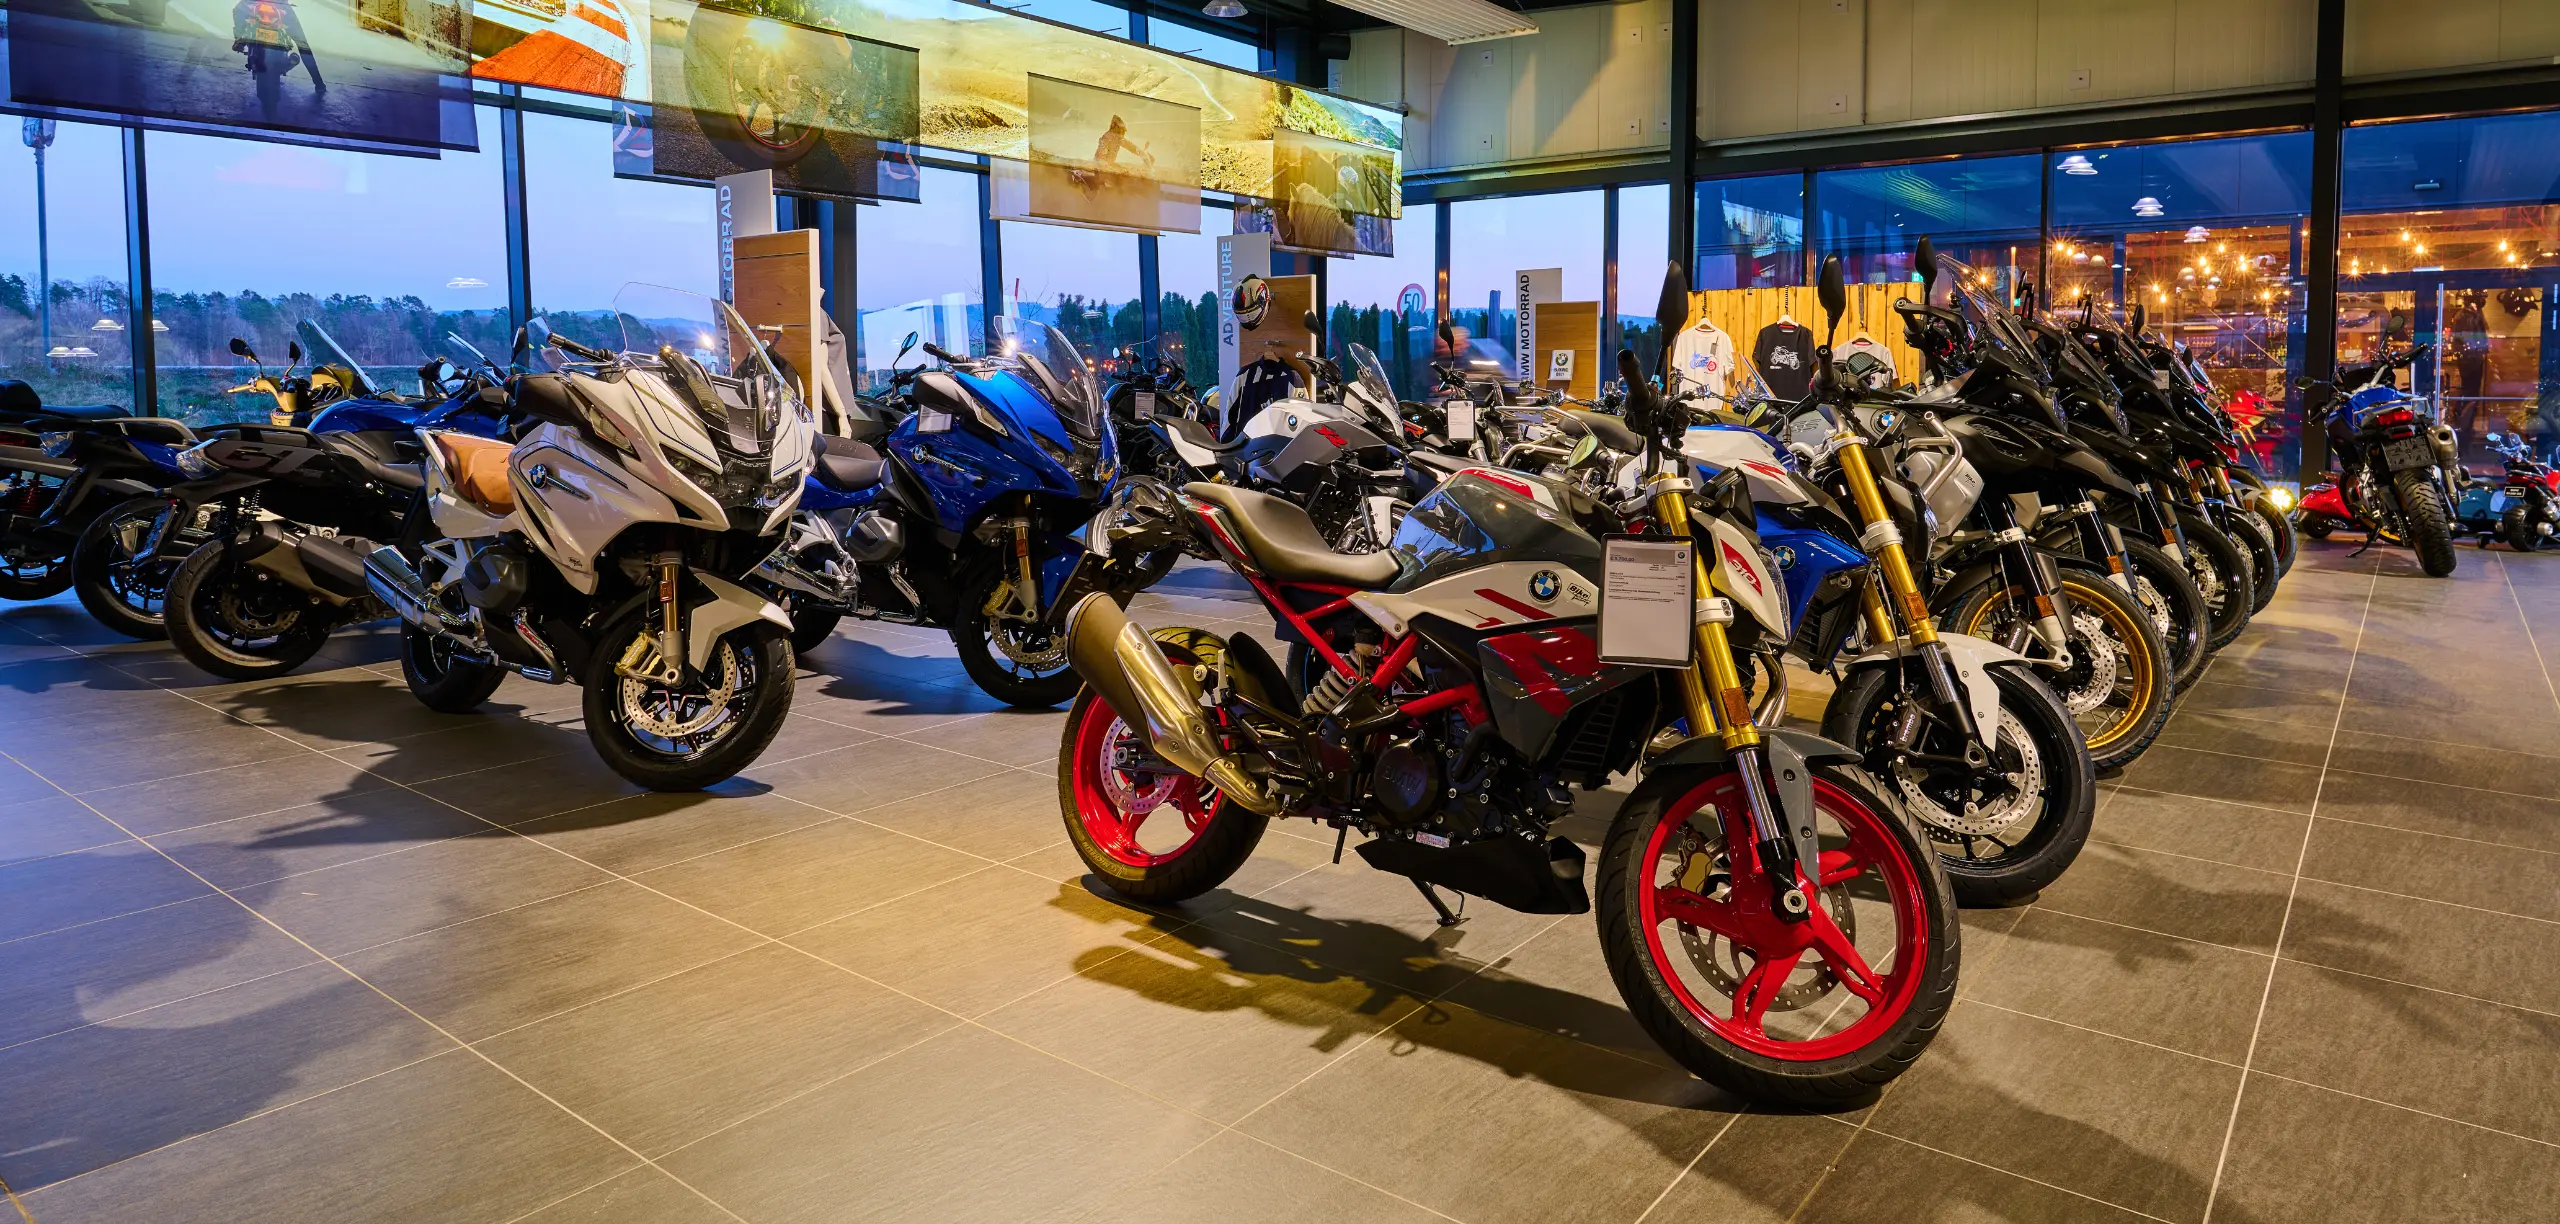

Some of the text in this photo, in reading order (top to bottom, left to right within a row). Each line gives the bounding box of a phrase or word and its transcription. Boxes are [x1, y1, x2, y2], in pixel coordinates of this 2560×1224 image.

[1221, 240, 1234, 347] ADVENTURE
[1404, 292, 1420, 313] 50
[1520, 274, 1530, 350] MOTORRAD
[1728, 558, 1758, 586] 310
[1569, 585, 1589, 598] Bike
[1899, 713, 1916, 743] brembo
[1382, 765, 1422, 794] BMW
